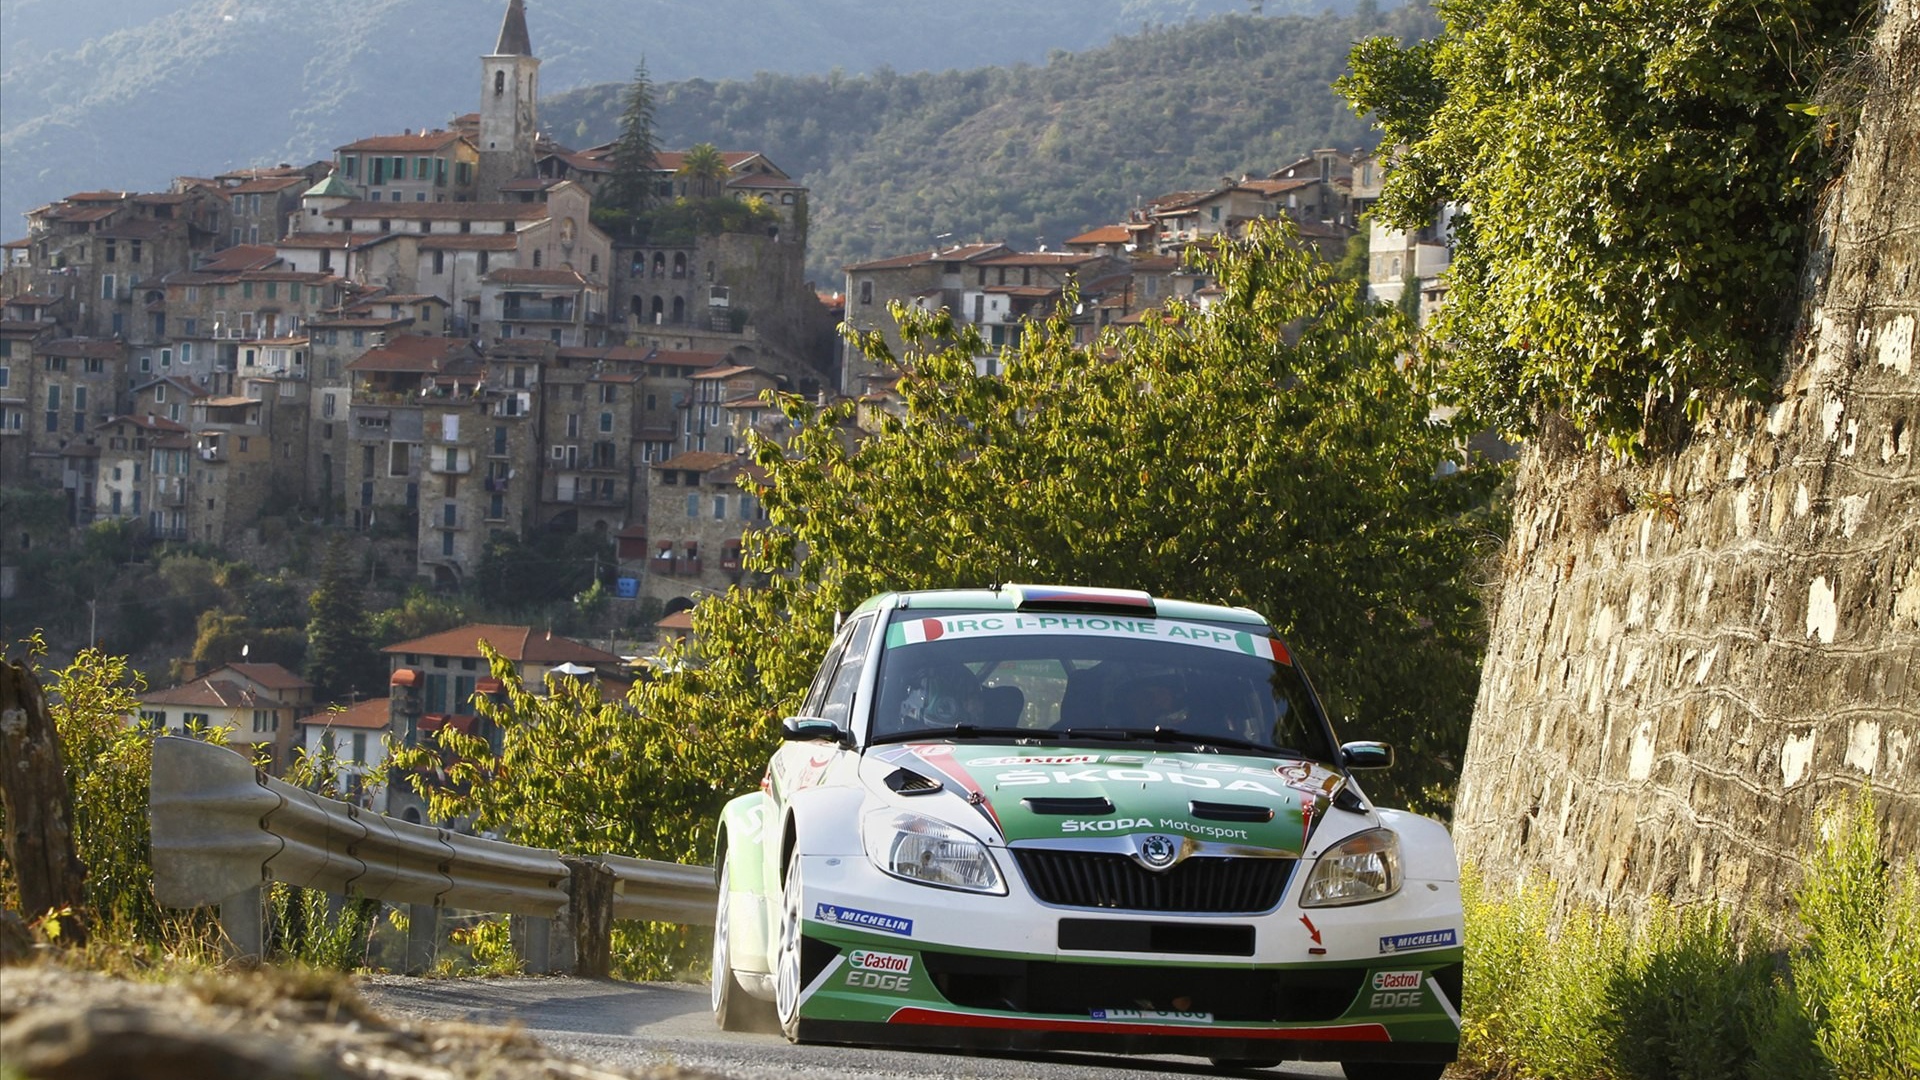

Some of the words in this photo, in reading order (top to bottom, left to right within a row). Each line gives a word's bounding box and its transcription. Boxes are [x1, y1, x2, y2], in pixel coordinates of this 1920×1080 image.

[947, 618, 1004, 633] IRC
[1015, 617, 1158, 635] I-PHONE
[1168, 625, 1232, 643] APP
[995, 769, 1282, 797] ŠKODA
[1061, 818, 1154, 832] ŠKODA
[1159, 818, 1248, 840] Motorsport
[840, 910, 909, 931] MICHELIN
[1398, 933, 1452, 946] MICHELIN
[864, 953, 909, 971] Castrol
[847, 972, 912, 992] EDGE
[1384, 974, 1418, 987] Castrol
[1371, 993, 1423, 1008] EDGE
